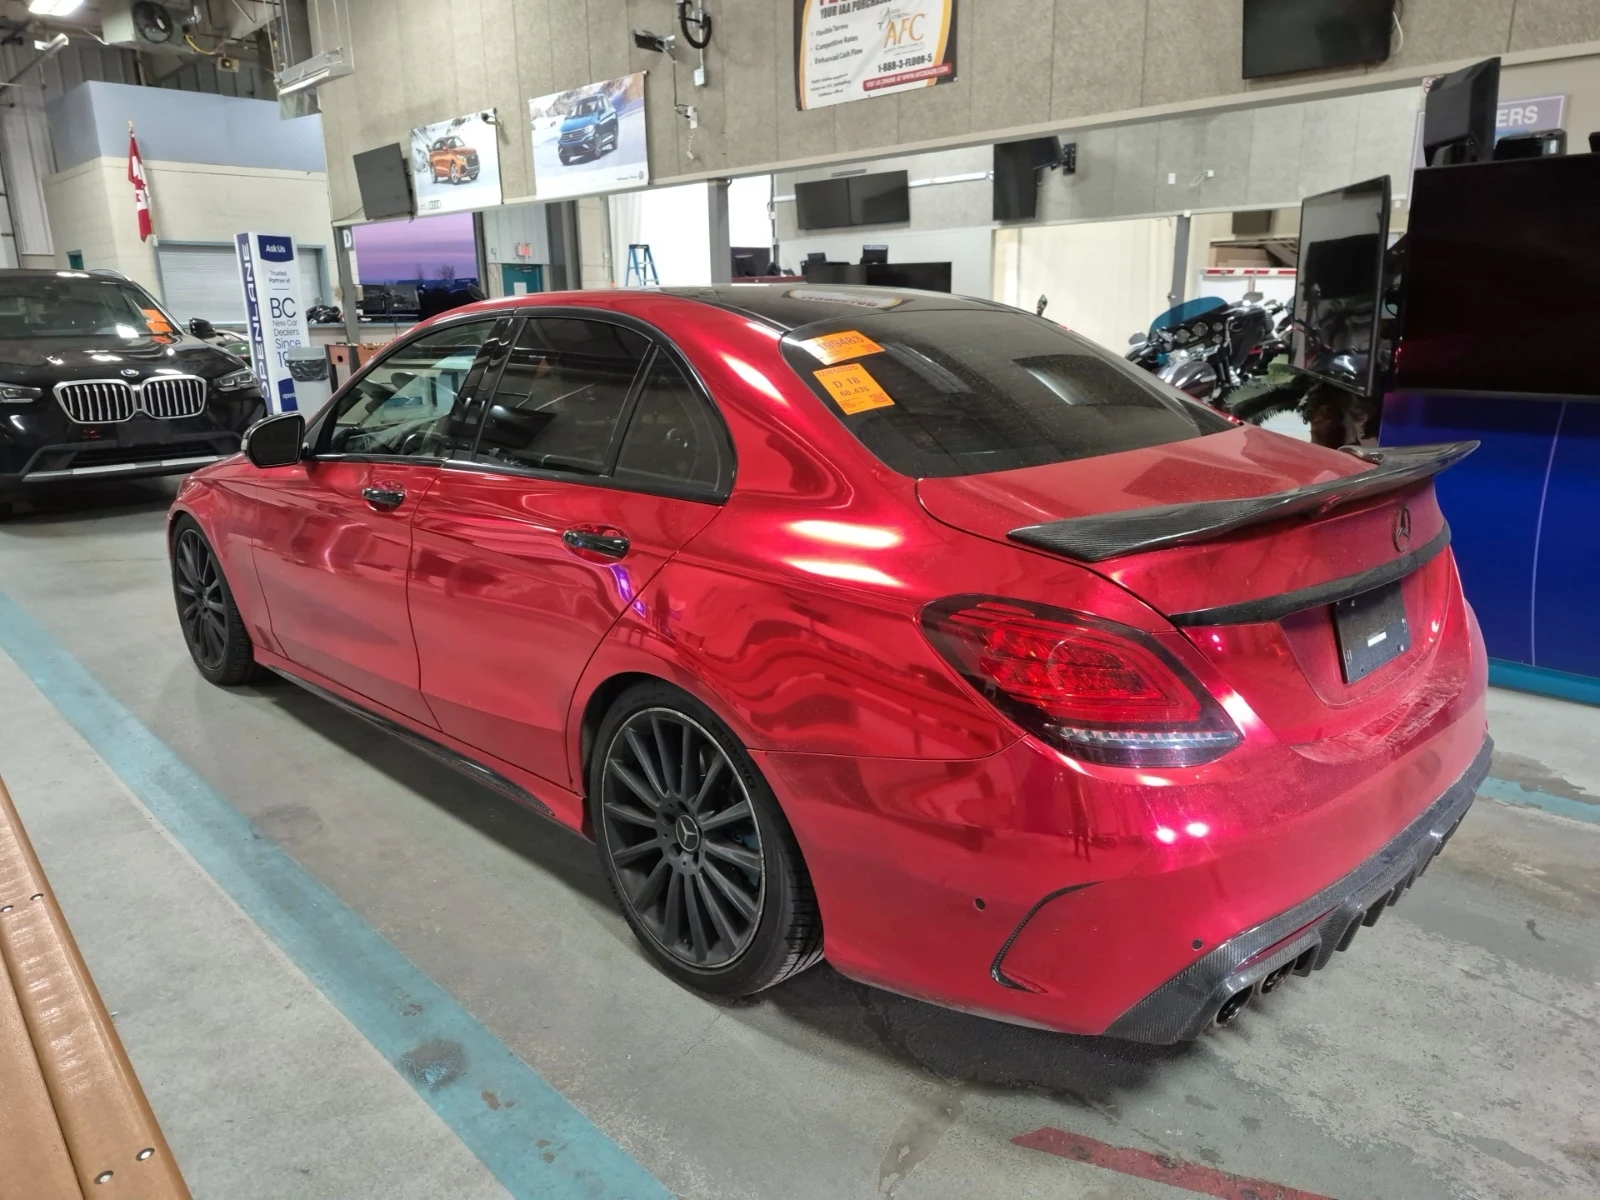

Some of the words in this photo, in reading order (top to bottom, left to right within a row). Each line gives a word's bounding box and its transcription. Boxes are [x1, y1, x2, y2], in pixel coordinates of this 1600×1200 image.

[883, 13, 925, 48] AFC
[815, 39, 843, 51] Competitive
[814, 53, 839, 64] Enhanced
[840, 51, 851, 59] Cash
[1497, 105, 1538, 127] ERS
[343, 229, 352, 248] D
[265, 244, 277, 253] Ask
[277, 245, 286, 253] Us
[270, 297, 296, 318] BC
[273, 328, 299, 336] Dealers
[275, 337, 301, 349] Since
[845, 376, 861, 385] 18
